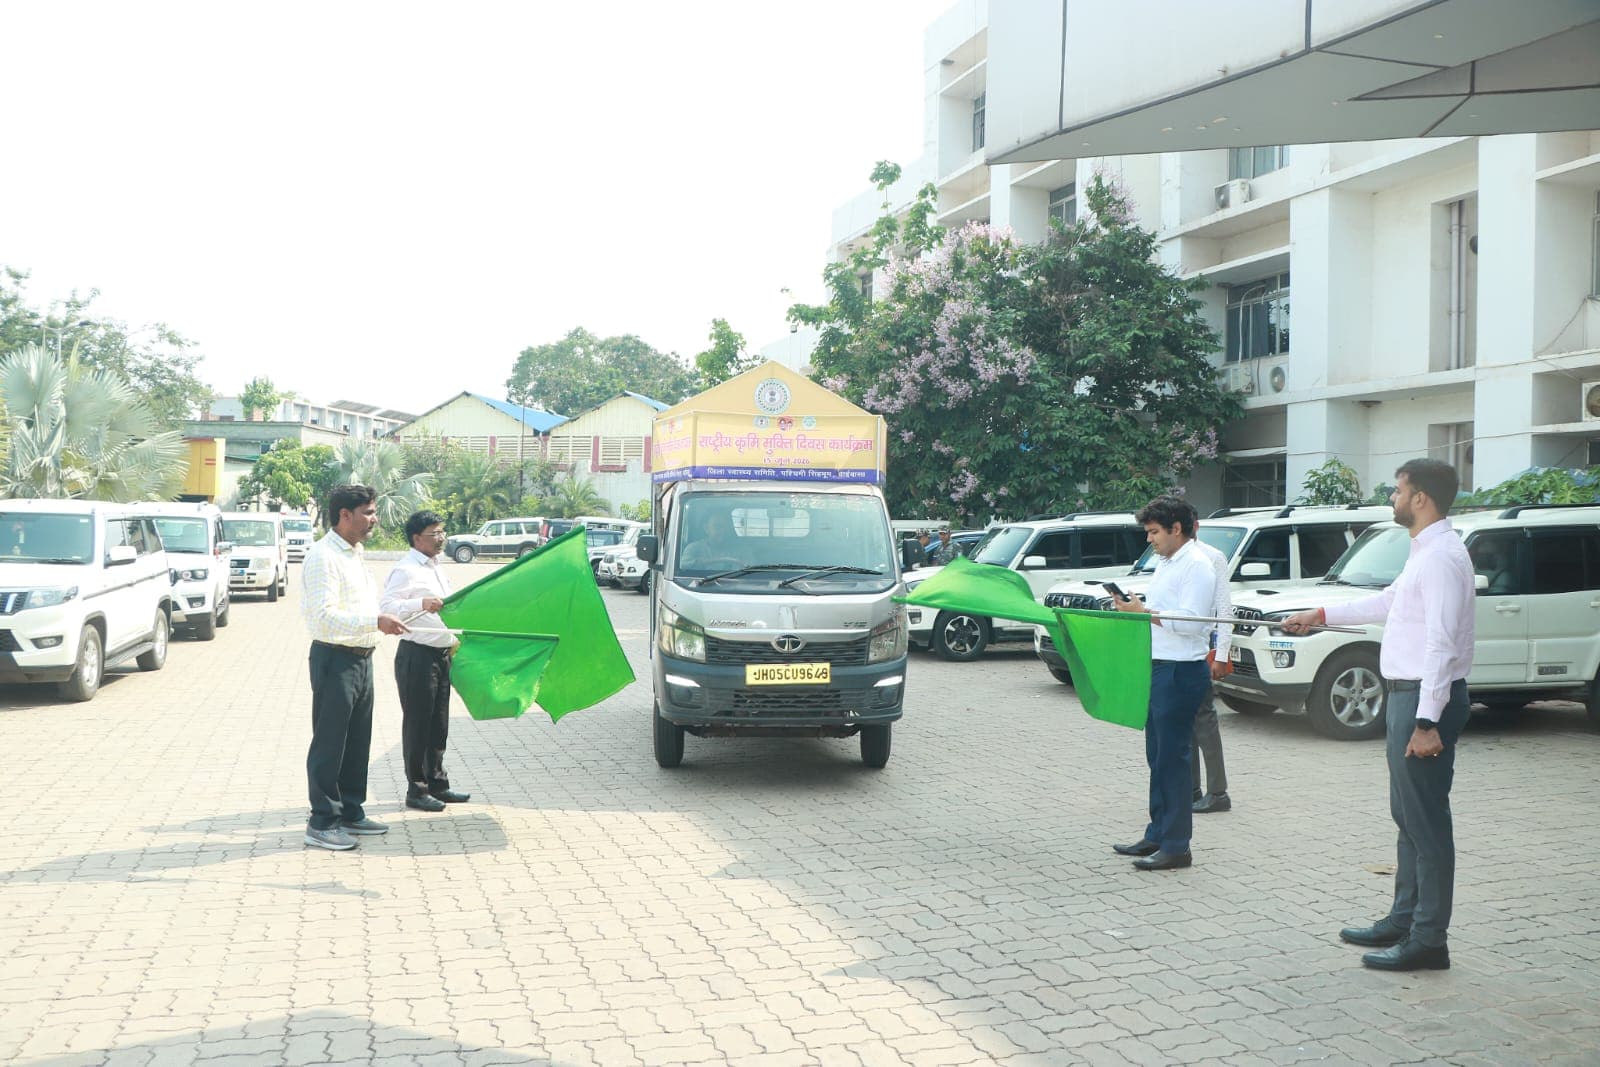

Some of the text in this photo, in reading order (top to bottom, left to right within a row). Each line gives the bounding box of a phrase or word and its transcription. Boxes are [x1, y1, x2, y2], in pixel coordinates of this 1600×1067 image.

[699, 432, 731, 454] राष्ट्रीय
[735, 433, 760, 454] कृमि
[763, 433, 793, 455] मुक्ति
[796, 433, 825, 450] दिवस
[828, 434, 873, 452] कार्यक्रम
